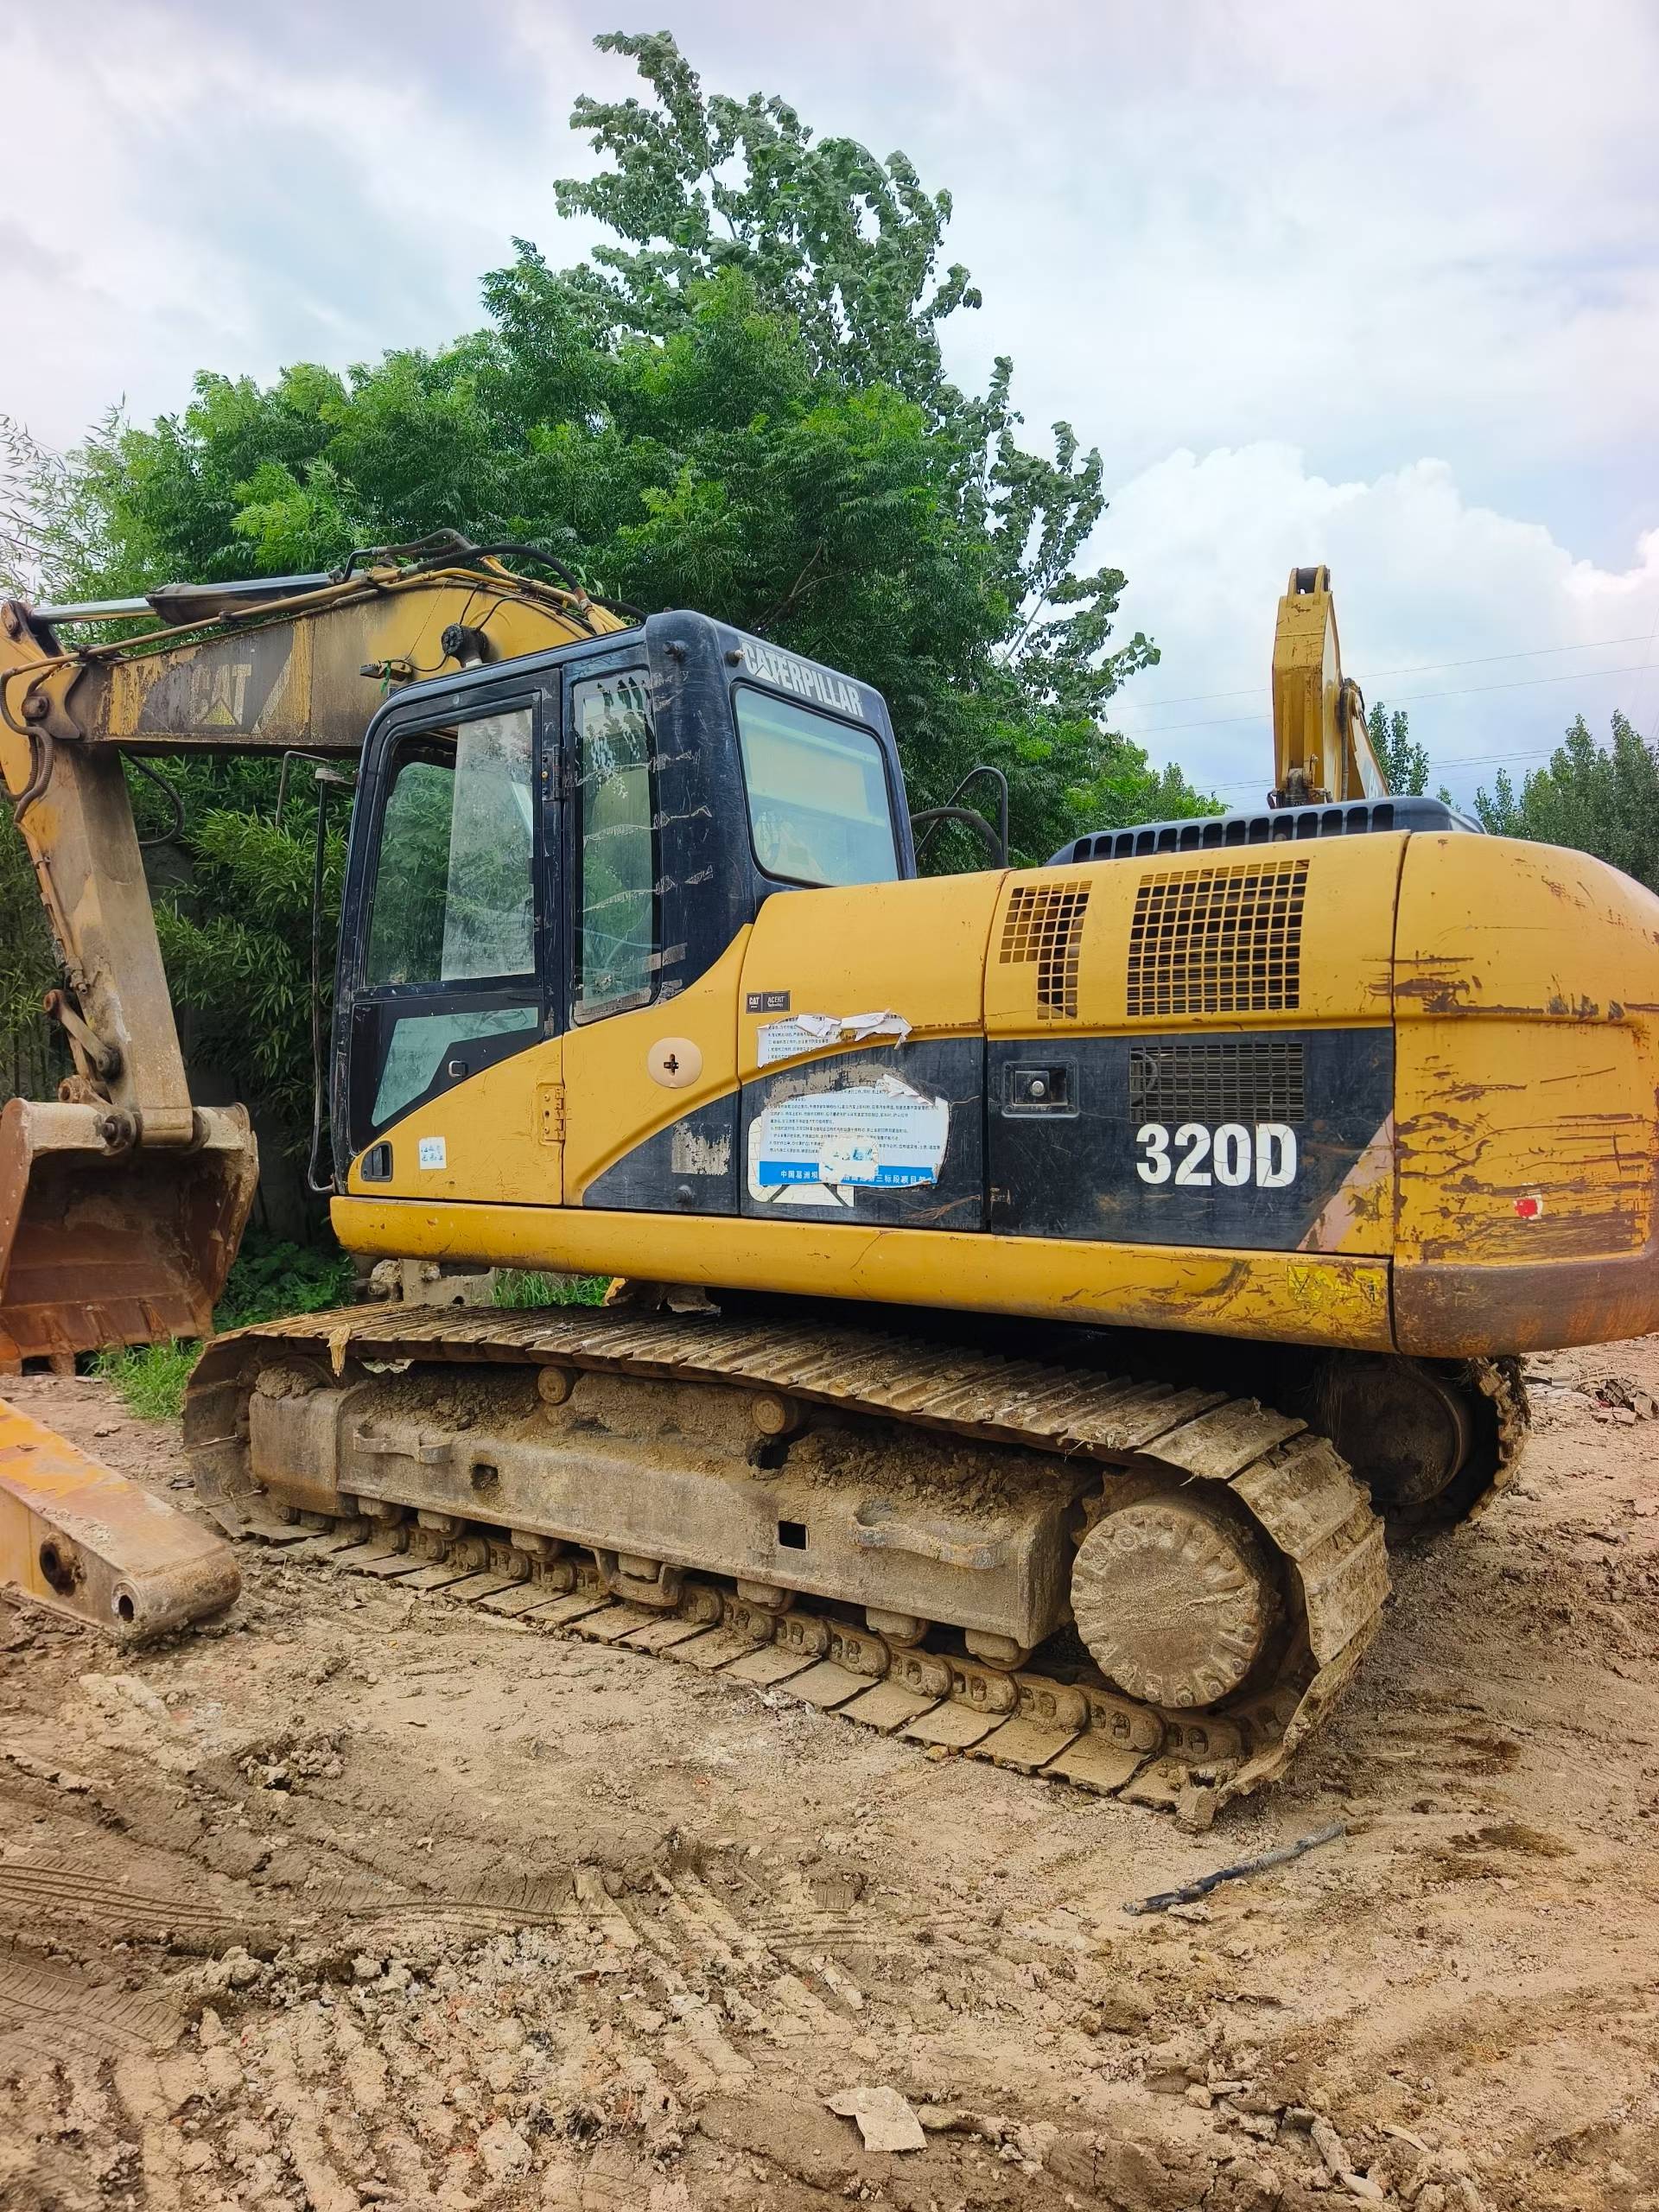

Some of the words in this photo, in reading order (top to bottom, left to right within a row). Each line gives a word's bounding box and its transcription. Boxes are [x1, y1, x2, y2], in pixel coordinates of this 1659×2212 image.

[191, 664, 252, 725] CAT
[741, 642, 864, 718] CATERPILLAR
[748, 996, 760, 1006] CAT
[1135, 1122, 1297, 1188] 320D
